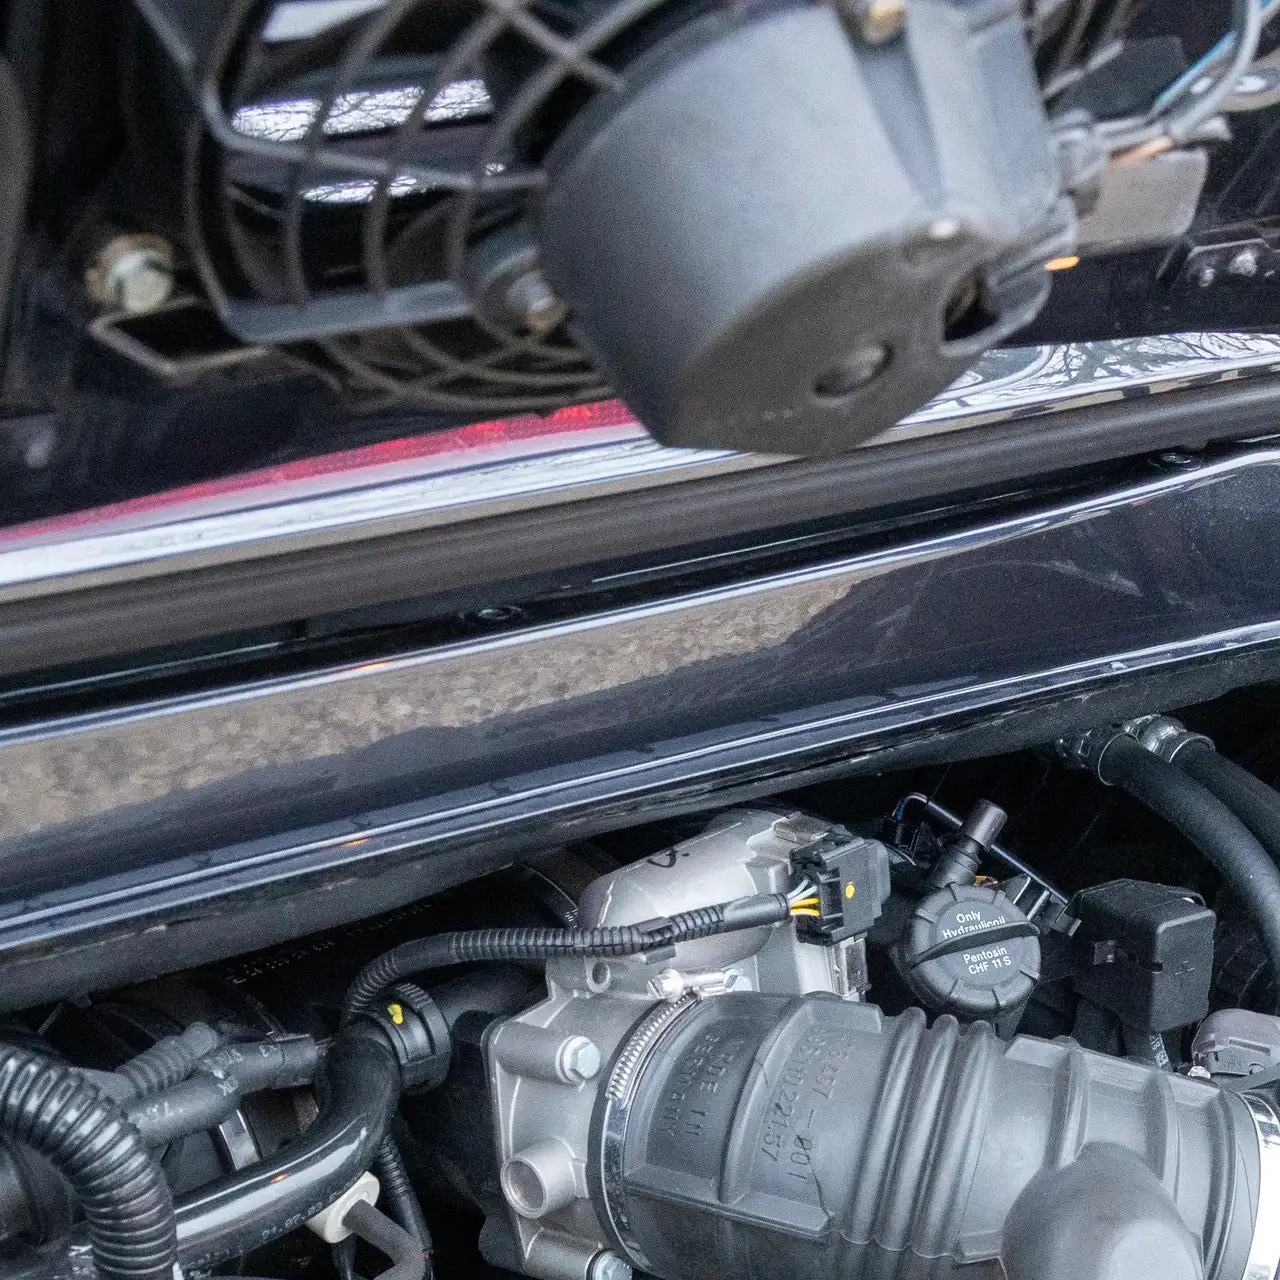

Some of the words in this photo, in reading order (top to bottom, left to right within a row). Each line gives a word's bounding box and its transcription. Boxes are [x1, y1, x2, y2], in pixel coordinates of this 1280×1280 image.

[956, 910, 981, 923] Only
[963, 946, 1007, 964] Pentosin
[968, 961, 989, 975] CHF
[991, 958, 1002, 970] 11
[1003, 955, 1012, 967] S
